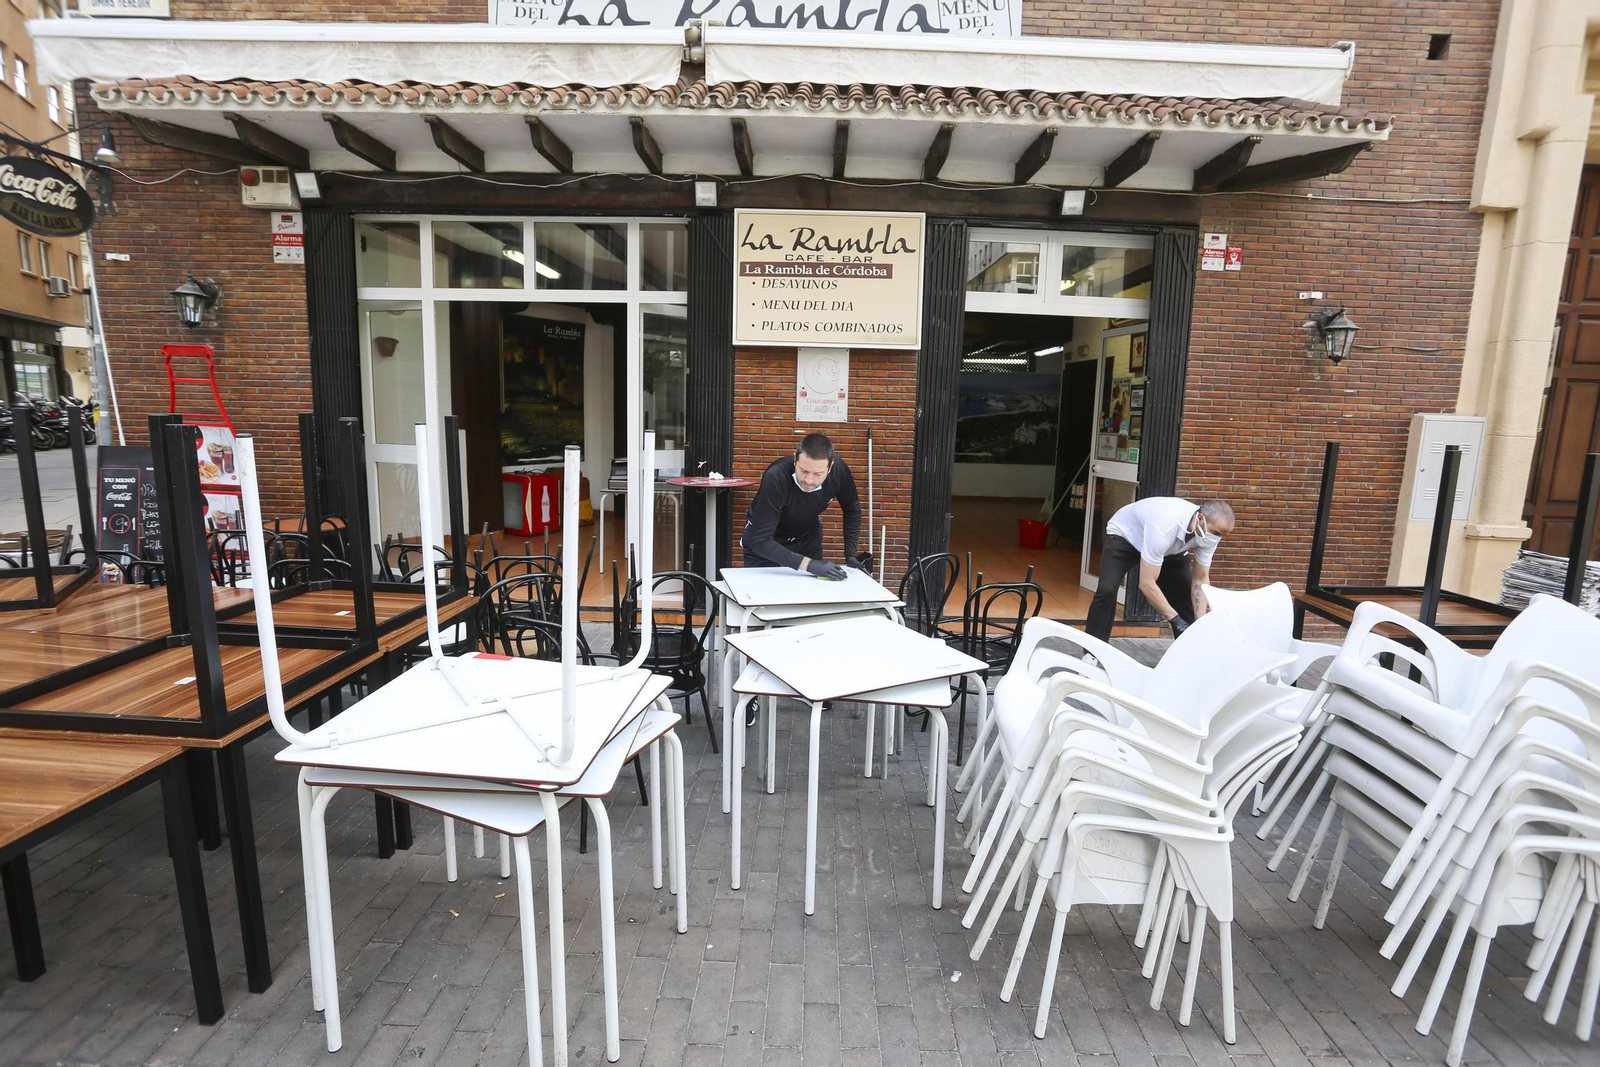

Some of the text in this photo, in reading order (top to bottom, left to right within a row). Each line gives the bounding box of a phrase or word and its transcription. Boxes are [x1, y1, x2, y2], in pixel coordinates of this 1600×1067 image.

[514, 6, 549, 20] DEL
[958, 15, 994, 30] DEL
[10, 201, 77, 230] BAR LA RAMBLA
[274, 234, 303, 242] Alarma
[741, 223, 916, 254] La Rambla
[785, 254, 825, 262] CAFE
[842, 255, 873, 263] BAR
[745, 264, 888, 276] La Rambla de Córdoba
[761, 278, 838, 290] DESAYUNOS
[761, 299, 854, 311] MENU DEL DIA
[543, 325, 581, 337] La Rambla
[761, 320, 904, 334] PLATOS COMBINADOS
